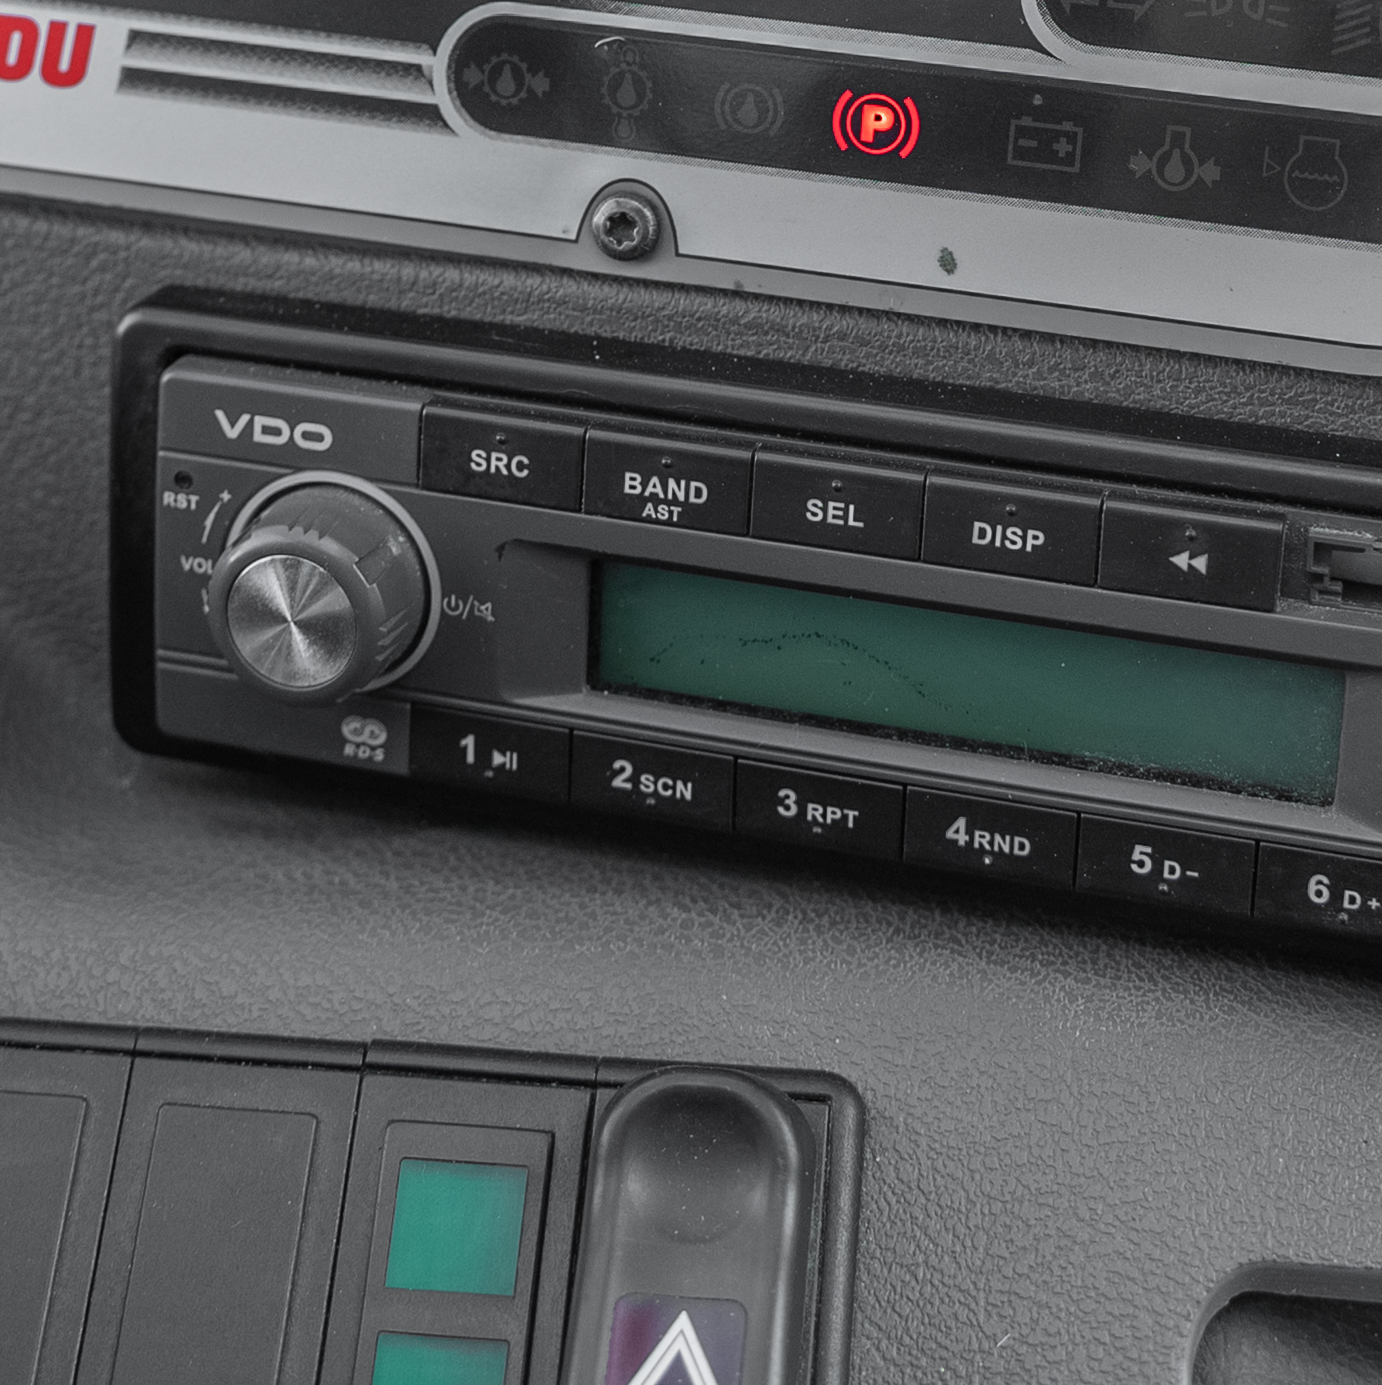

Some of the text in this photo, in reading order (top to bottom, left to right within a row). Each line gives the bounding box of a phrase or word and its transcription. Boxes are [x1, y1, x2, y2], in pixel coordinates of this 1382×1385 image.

[860, 103, 894, 143] P
[214, 408, 333, 451] VDO
[469, 449, 531, 478] SRC
[162, 490, 200, 511] RST
[622, 471, 709, 505] BAND
[641, 501, 682, 522] AST
[805, 498, 865, 529] SEL
[971, 522, 1046, 553] DISP
[459, 733, 475, 765] 1
[610, 760, 693, 803] 2 SCN
[775, 788, 860, 829] 3 RPT
[944, 817, 1032, 858] 4 RND
[1129, 845, 1153, 876] 5
[1307, 874, 1331, 905] 6
